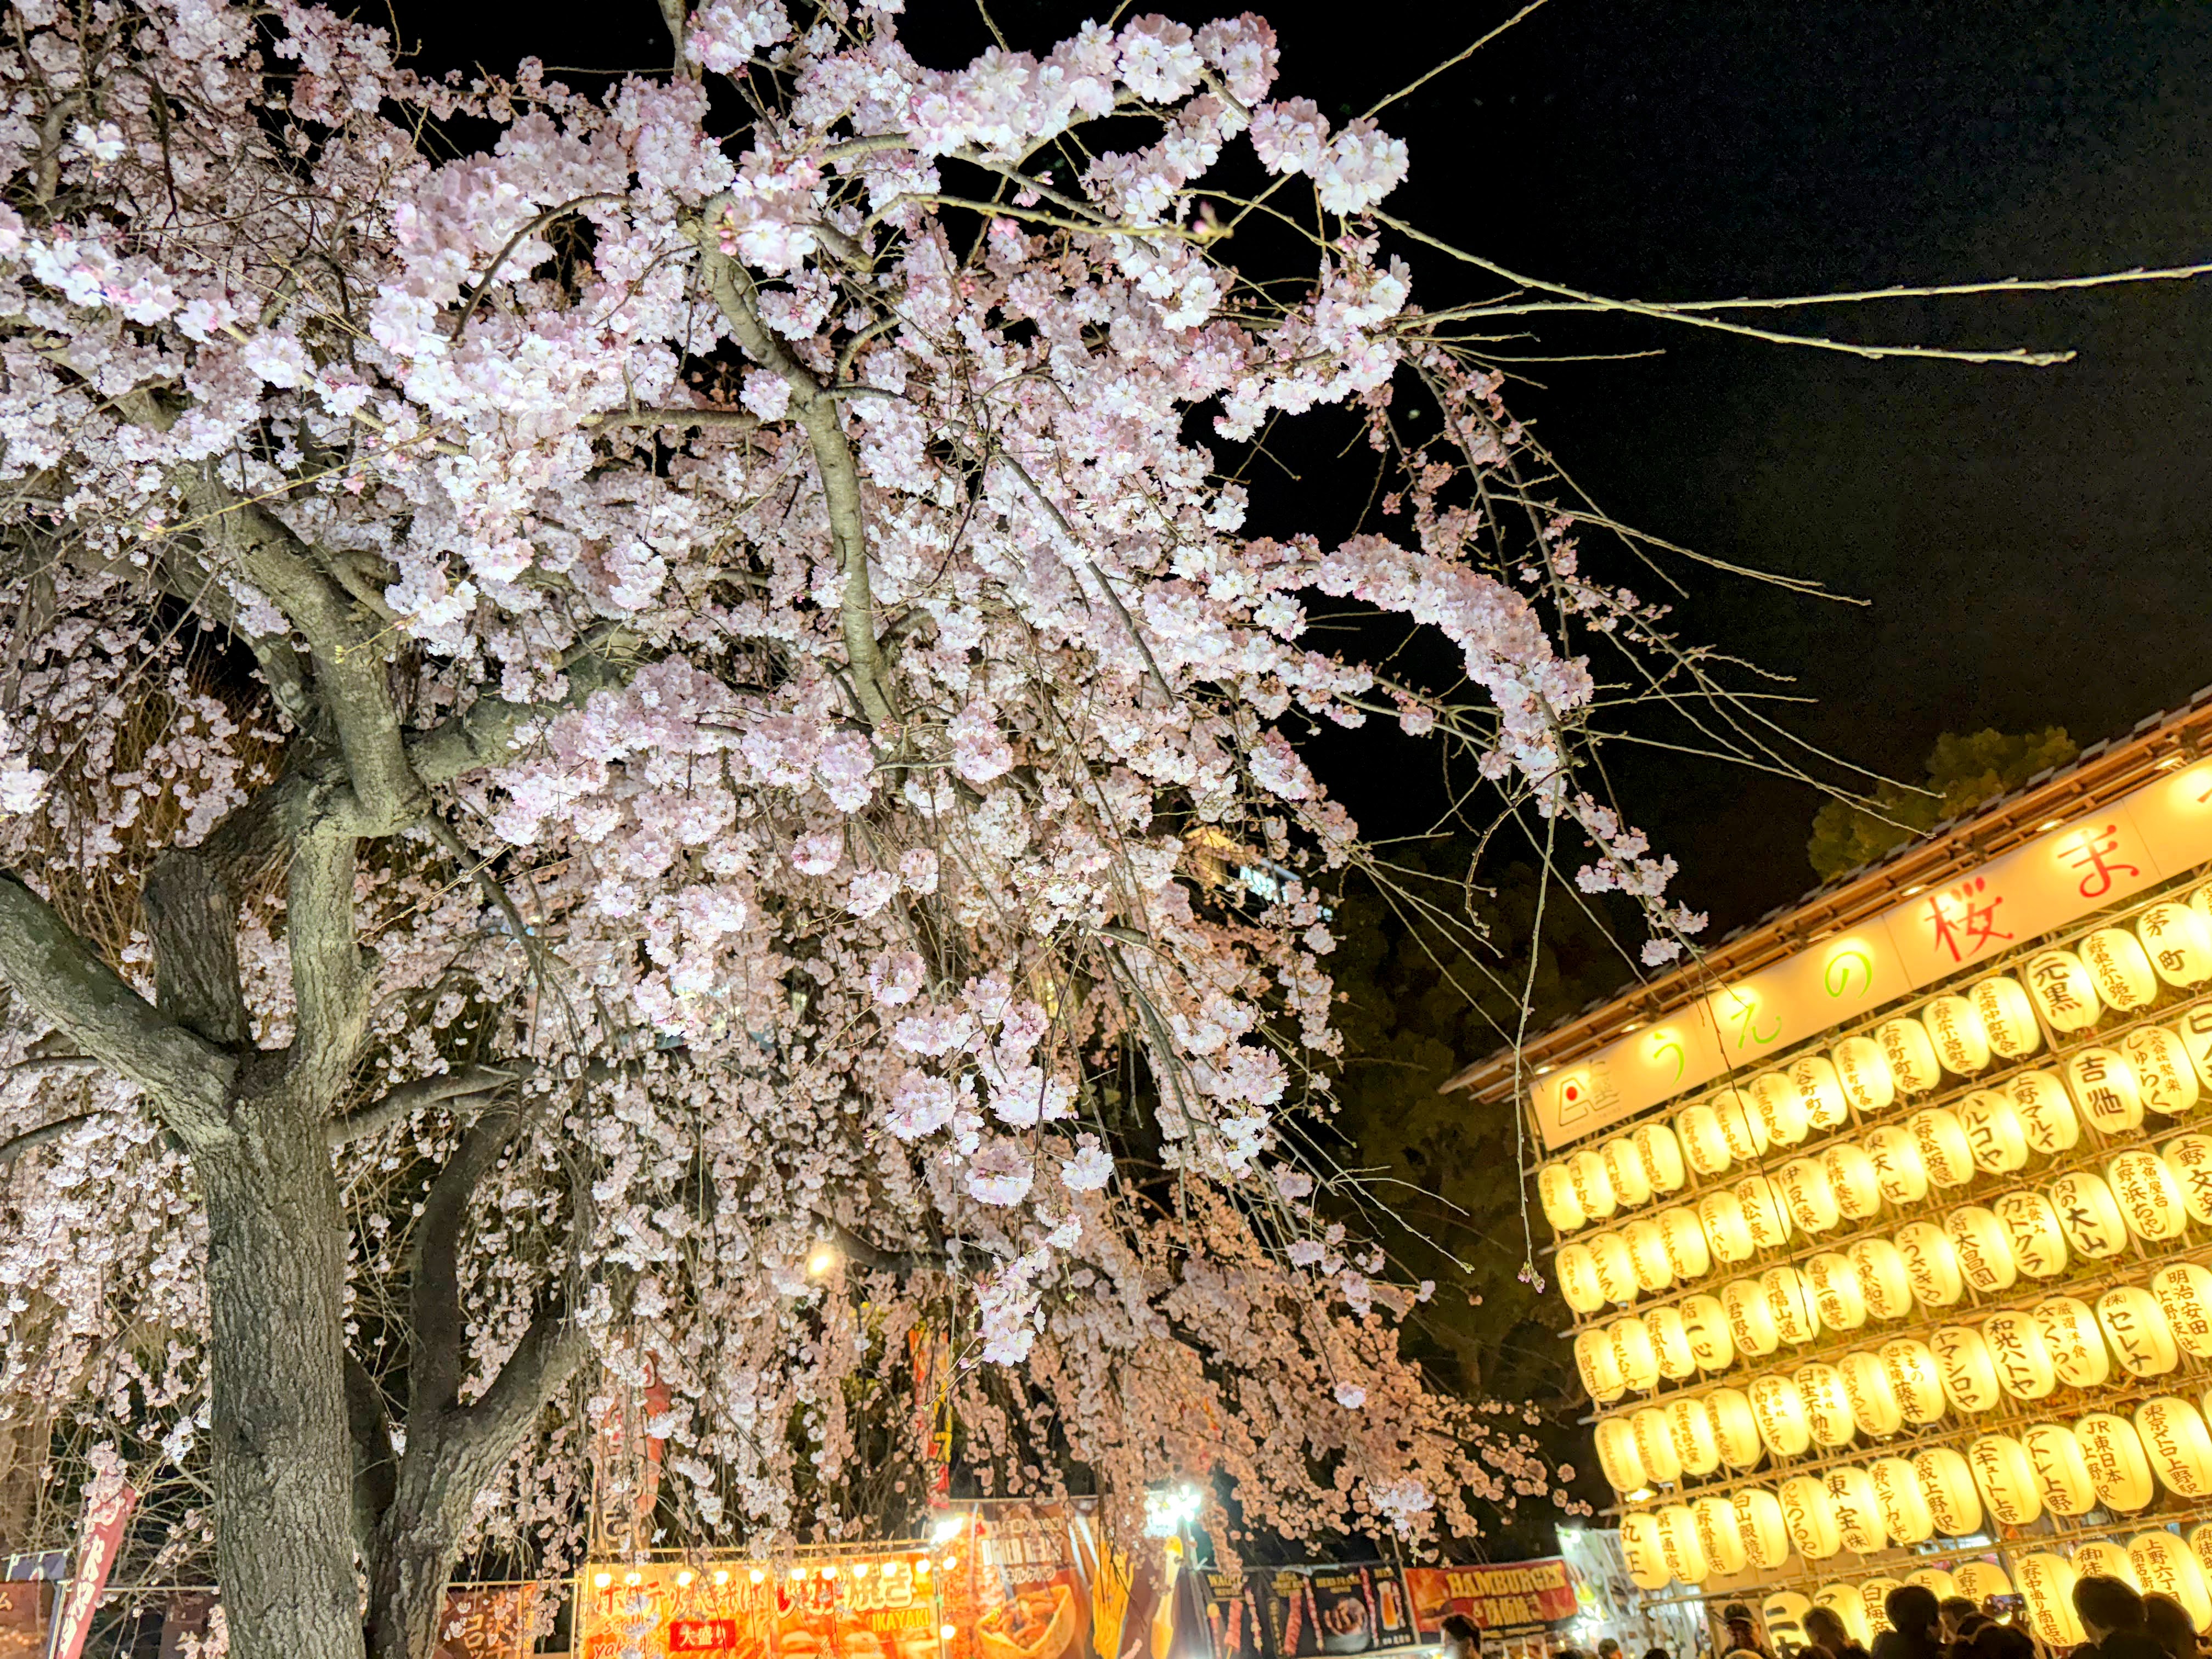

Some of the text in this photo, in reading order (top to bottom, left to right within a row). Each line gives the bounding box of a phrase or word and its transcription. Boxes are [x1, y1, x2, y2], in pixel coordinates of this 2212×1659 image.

[1653, 790, 2212, 1085] うえの桜ま
[2140, 909, 2185, 971] 茅町
[2034, 957, 2081, 1015] 元黒
[2076, 1057, 2124, 1116] 吉池
[2127, 1035, 2170, 1112] じゅらく
[2013, 1077, 2053, 1153] 上野マルイ
[1914, 1116, 1954, 1188] 上野松坂屋
[2137, 1157, 2168, 1207] 地魚屋台
[2002, 1199, 2043, 1271] カドクラ
[2025, 1196, 2047, 1233] 立飲み
[2051, 1180, 2107, 1256] 肉の大山
[2115, 1160, 2165, 1239] 上野浜ちゃん
[2058, 1303, 2086, 1358] 厳選洋食
[2158, 1288, 2199, 1353] 上野支社
[2167, 1269, 2209, 1335] 明治安田
[1903, 1345, 1924, 1381] きもの
[1937, 1332, 1978, 1410] ヤマシロヤ
[1990, 1319, 2034, 1398] 和光ハトヤ
[2034, 1307, 2079, 1384] さくらい
[1972, 1441, 2017, 1524] エキュート上野
[2028, 1431, 2071, 1514] アトレ上野
[2081, 1441, 2114, 1503] 上野駅
[2087, 1421, 2124, 1487] JR東日本
[2145, 1404, 2197, 1497] 東京メトロ上野駅
[1912, 1454, 1958, 1533] 京成上野駅
[871, 1607, 930, 1633] IKAYAKI
[1957, 1567, 1983, 1607] 上野中
[2021, 1560, 2069, 1645] 上野中通り商店街
[679, 1624, 727, 1647] 大盛り
